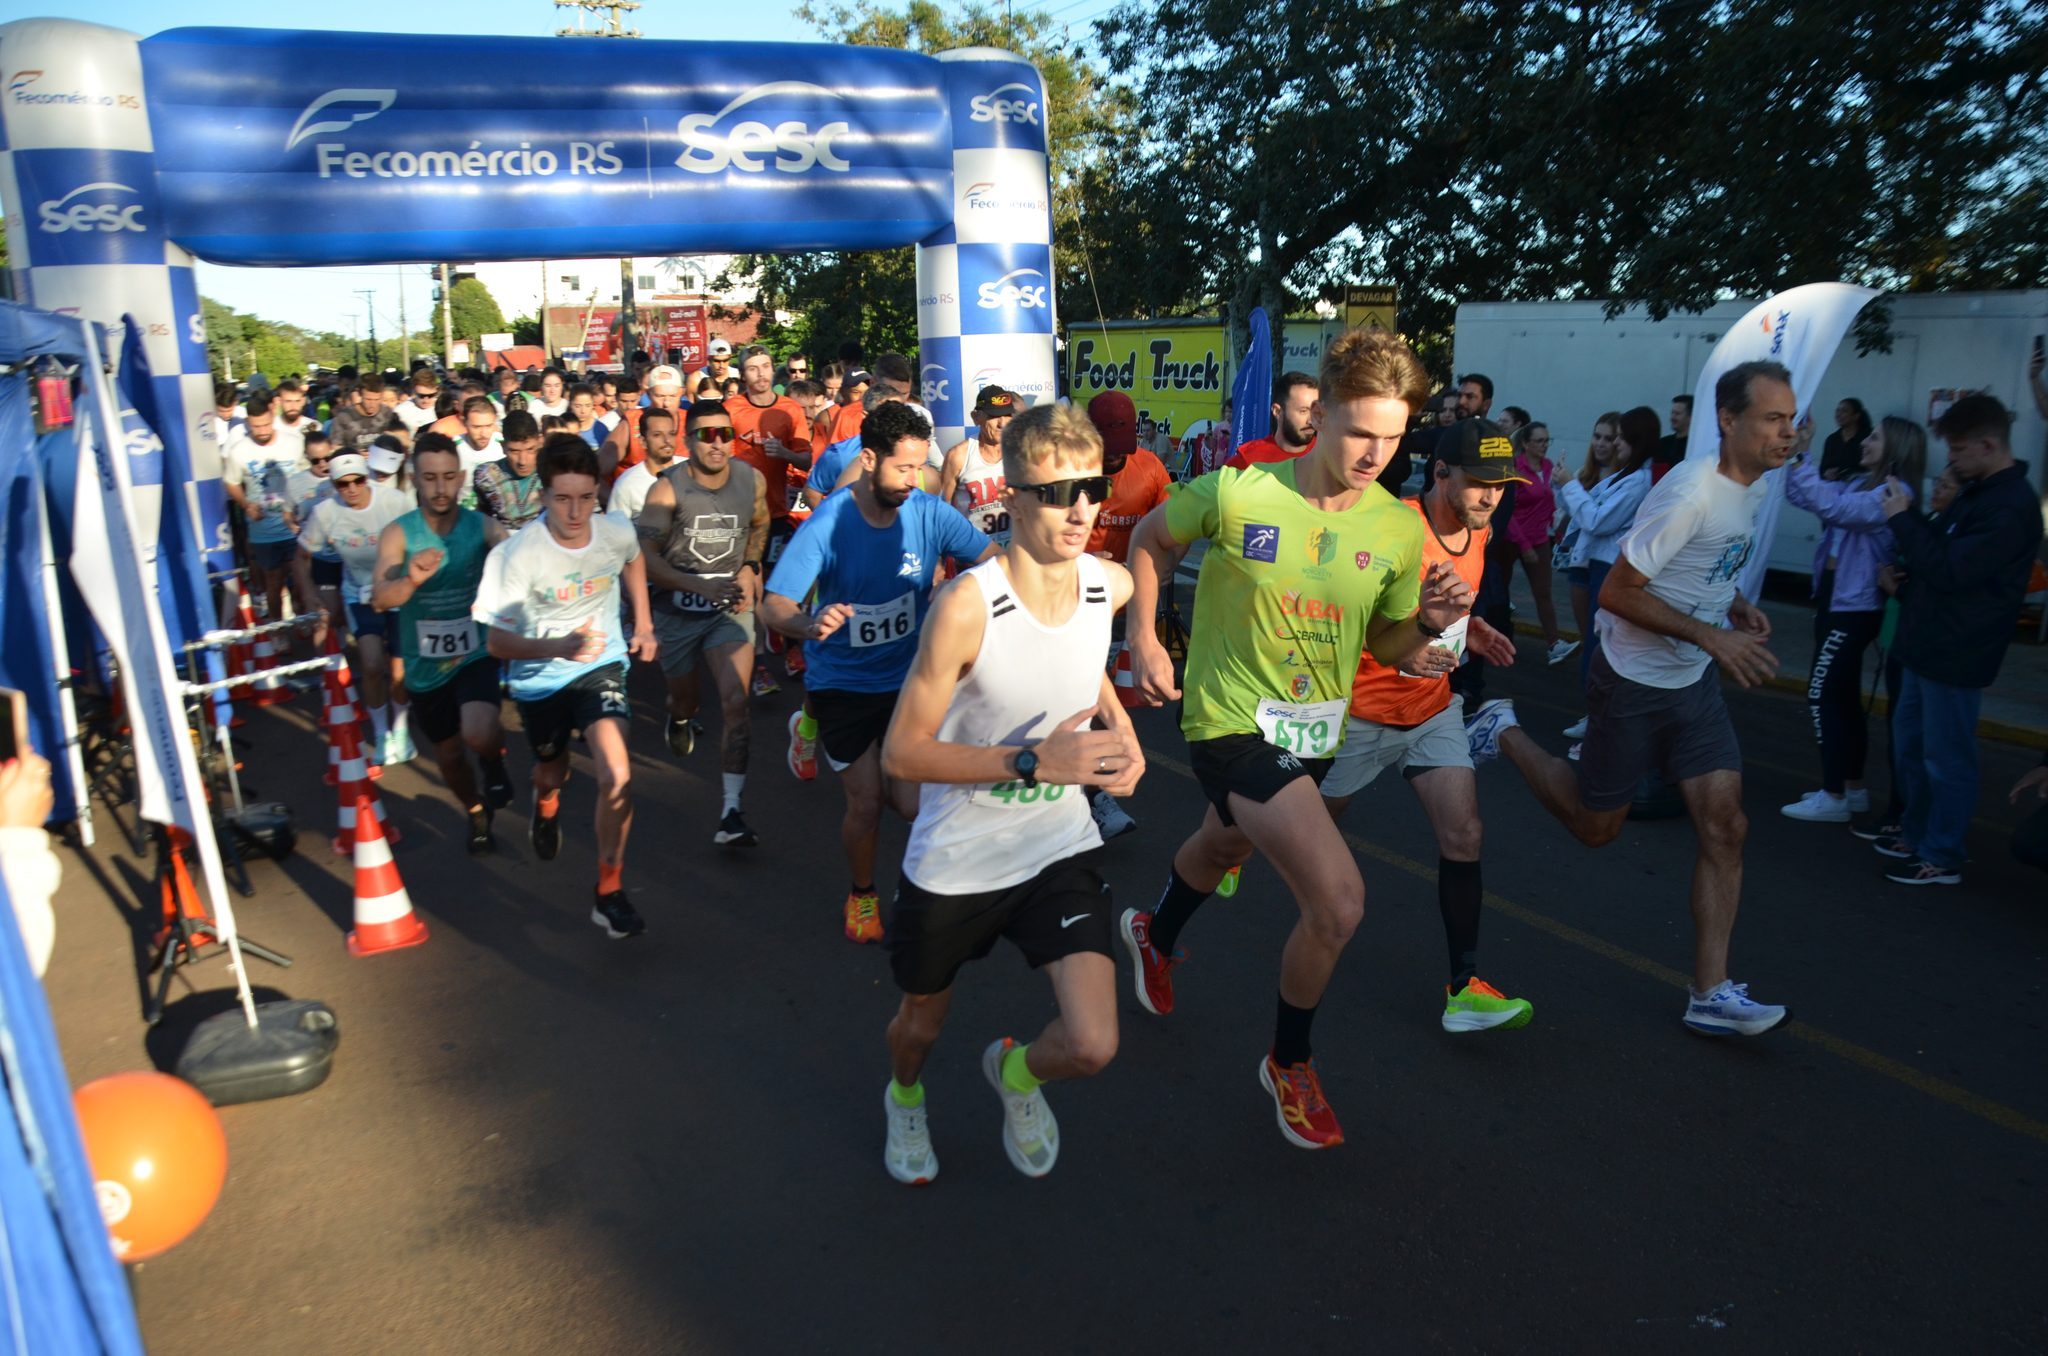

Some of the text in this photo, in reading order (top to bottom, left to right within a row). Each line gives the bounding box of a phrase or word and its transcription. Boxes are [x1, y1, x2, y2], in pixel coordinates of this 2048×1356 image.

[118, 94, 140, 109] RS
[317, 140, 623, 179] Fecomércio RS
[970, 198, 1035, 209] Fecoércio
[939, 293, 954, 305] RS
[1350, 291, 1394, 303] DEVAGAR
[1073, 339, 1222, 392] Food Truck
[982, 511, 1011, 535] 30
[1281, 594, 1345, 624] DUBAI
[860, 612, 908, 644] 616
[426, 630, 470, 654] 781
[1807, 628, 1849, 700] GROWTH
[1274, 719, 1329, 754] 479
